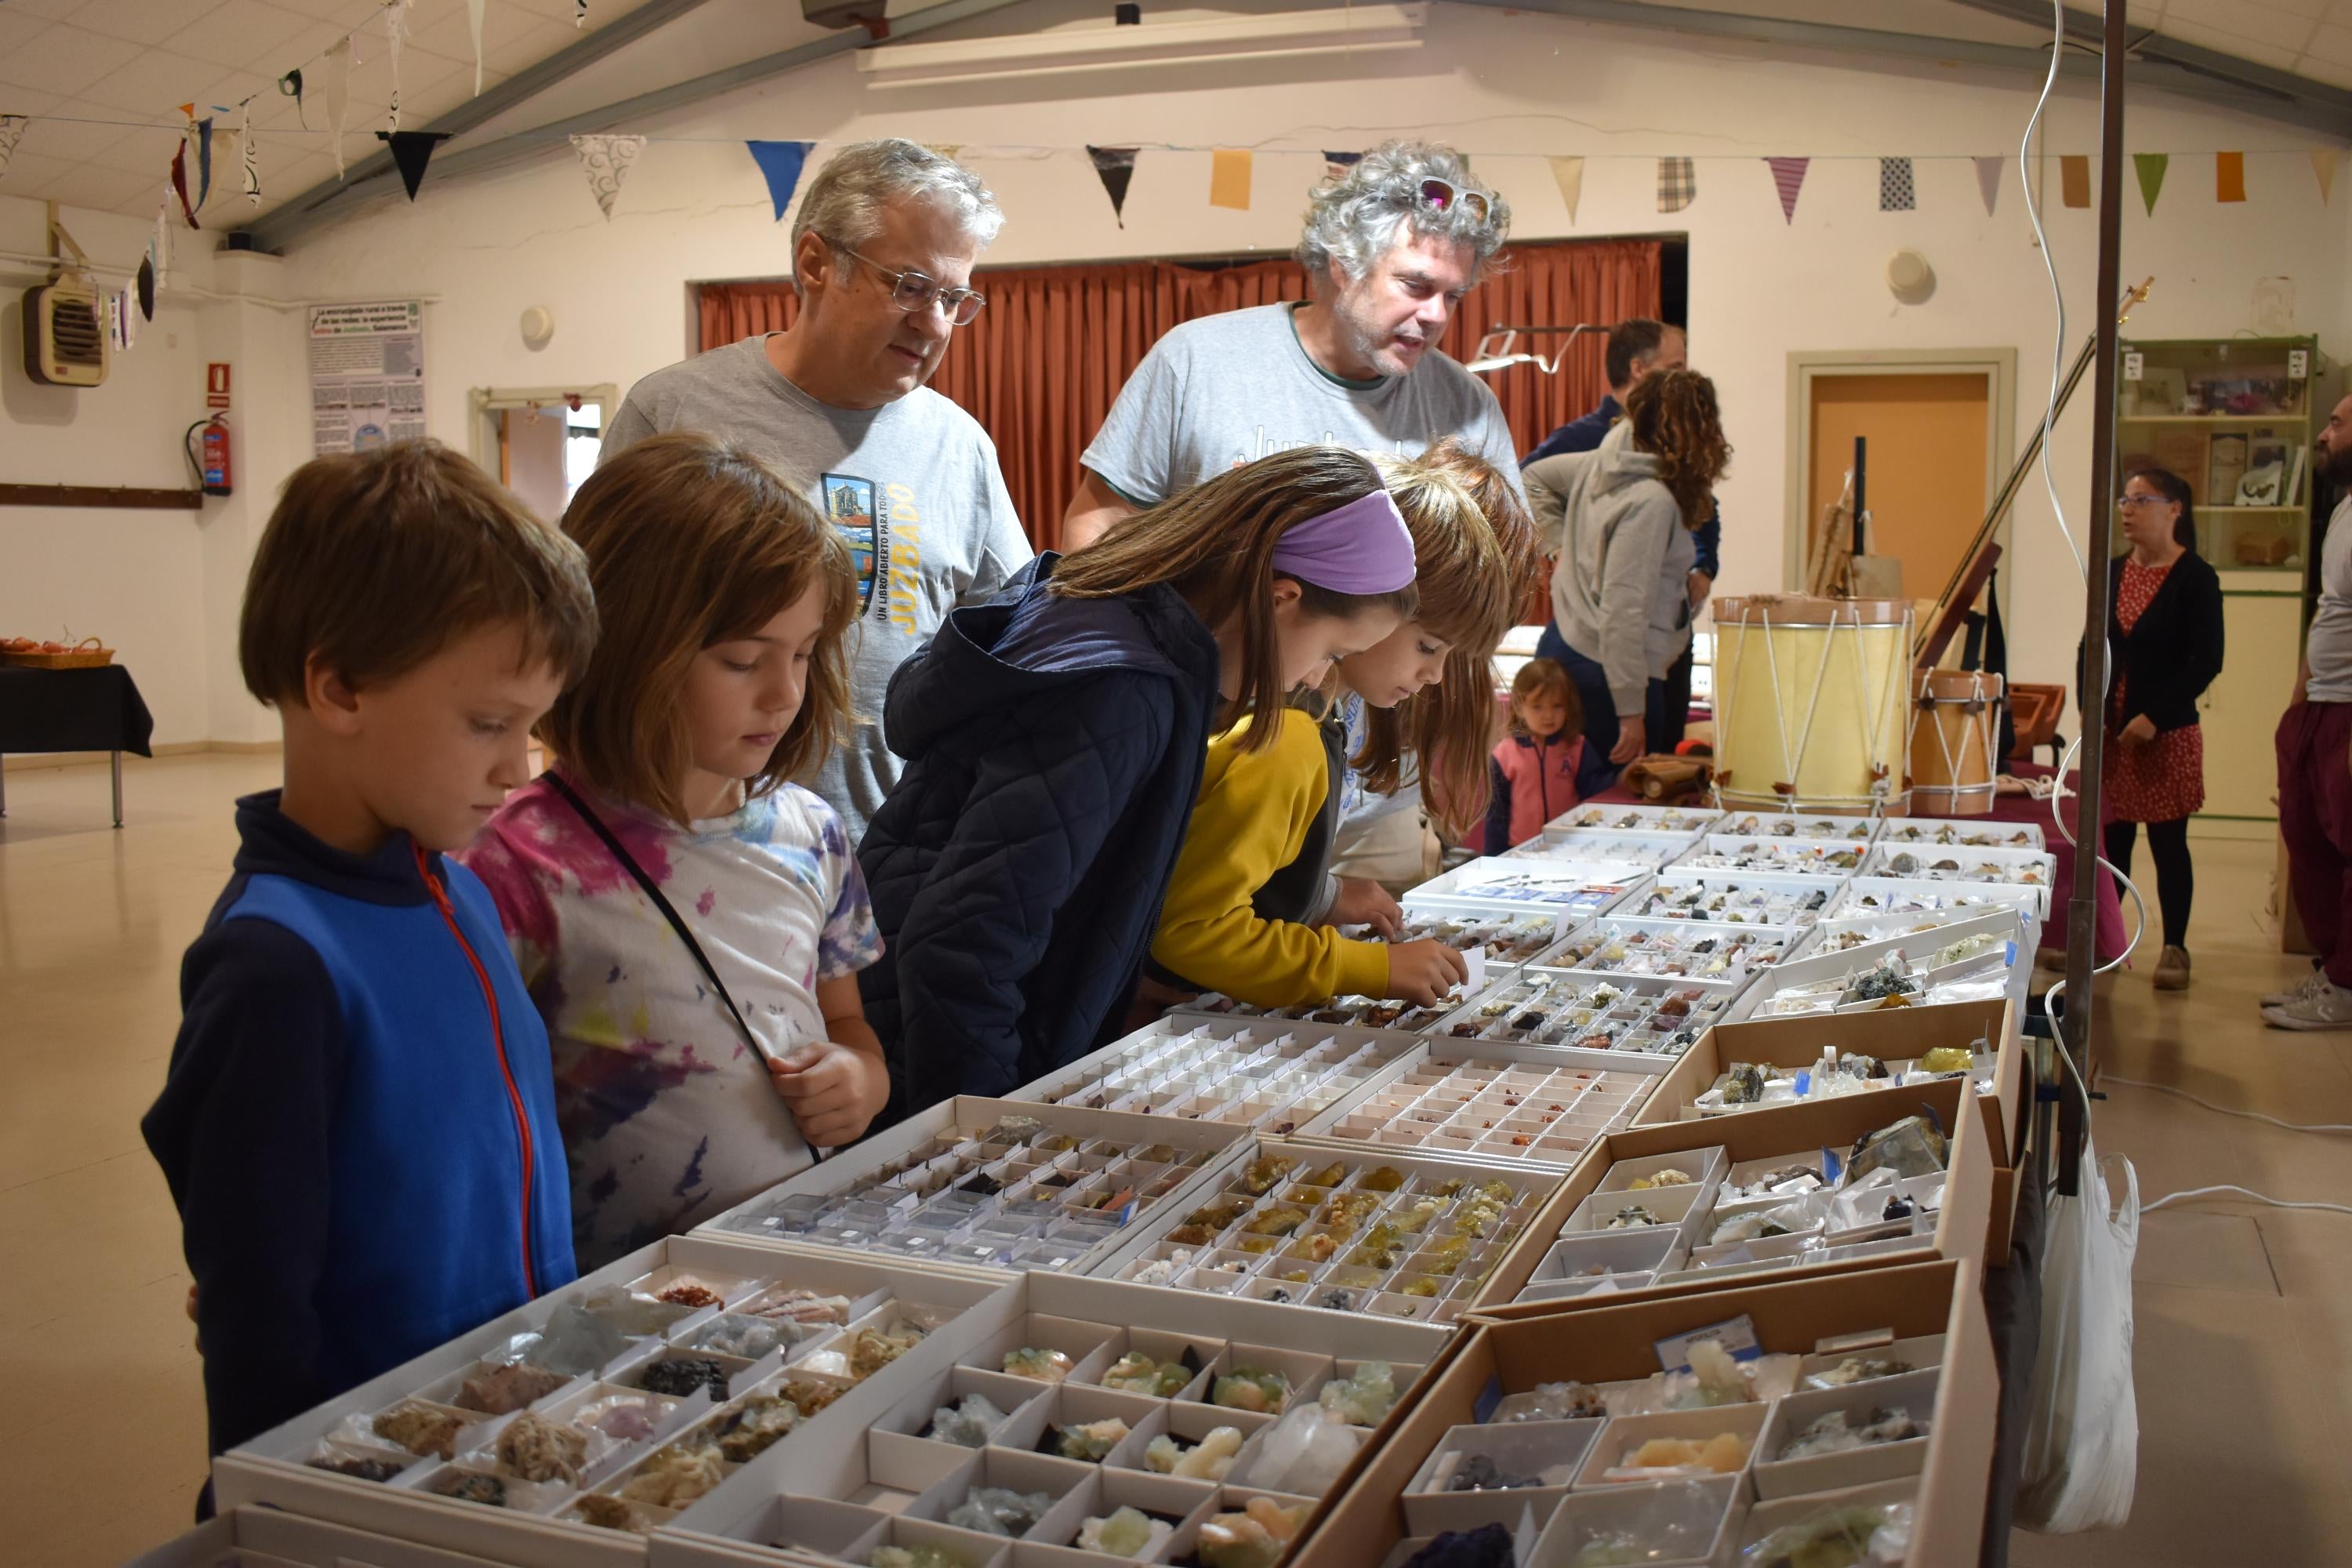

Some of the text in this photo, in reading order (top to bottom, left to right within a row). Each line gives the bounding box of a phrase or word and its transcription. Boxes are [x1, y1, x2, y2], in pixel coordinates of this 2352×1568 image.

[880, 513, 889, 535] PARA
[880, 538, 889, 575] ABIERTO
[887, 482, 920, 636] JUZBADO
[878, 577, 888, 604] LIBRO
